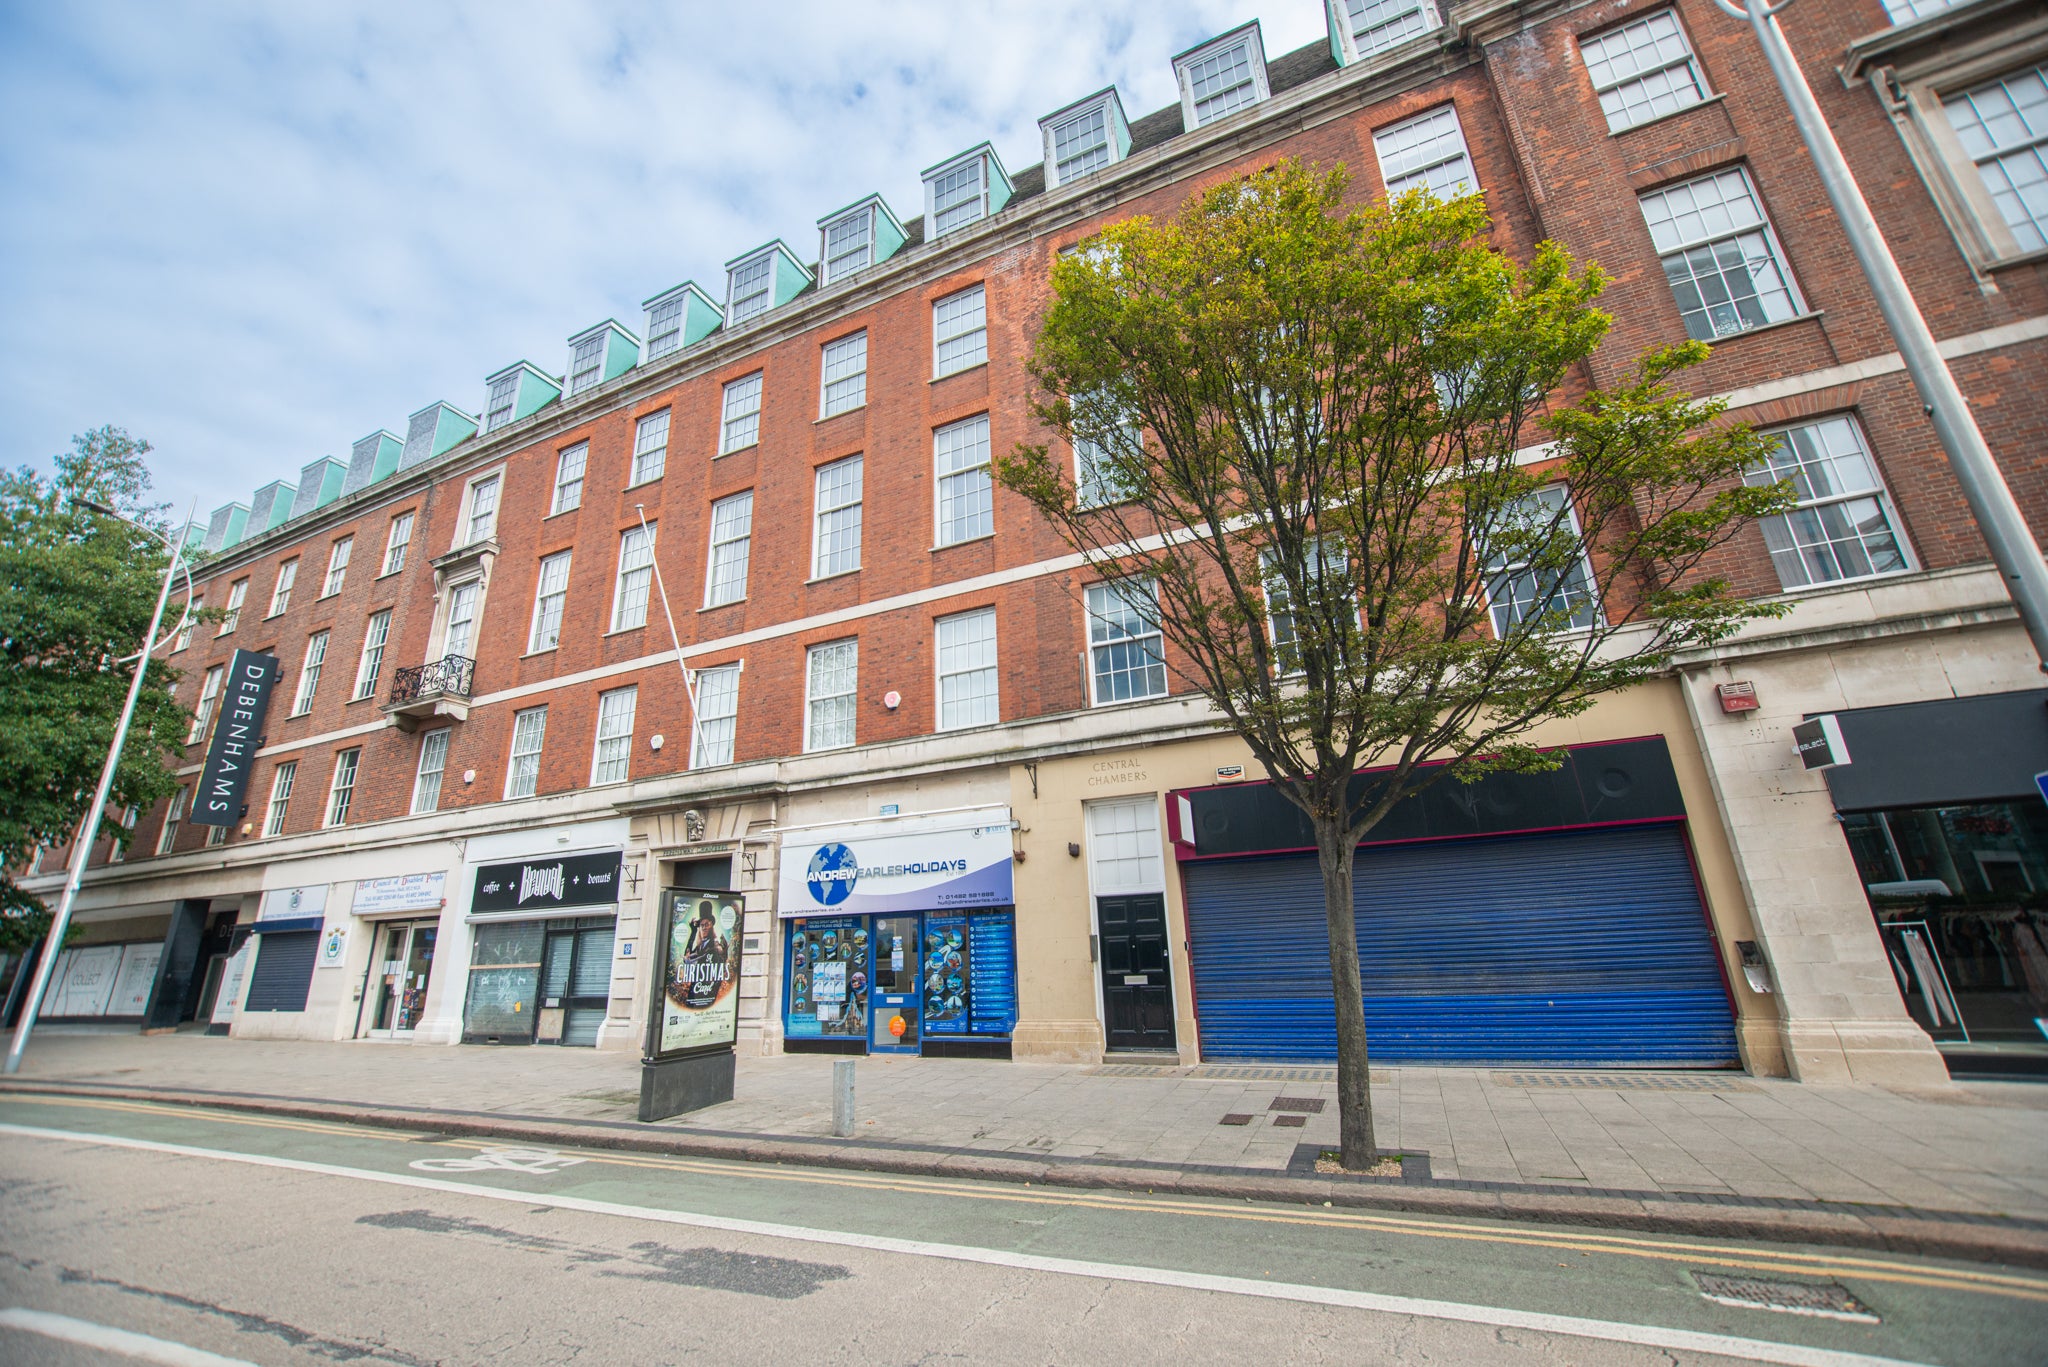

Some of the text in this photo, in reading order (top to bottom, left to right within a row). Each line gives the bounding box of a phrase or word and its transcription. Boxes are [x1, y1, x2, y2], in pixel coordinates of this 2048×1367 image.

[208, 664, 265, 812] DEBENHAMS
[1799, 737, 1826, 752] select
[1093, 758, 1141, 773] CENTRAL
[1087, 771, 1148, 787] CHAMBERS
[806, 868, 858, 882] ANDREW
[483, 880, 501, 894] coffee
[587, 872, 612, 885] donuts
[72, 972, 101, 986] COLLECT
[676, 962, 731, 983] CHRISTMAS
[693, 981, 715, 996] Carol
